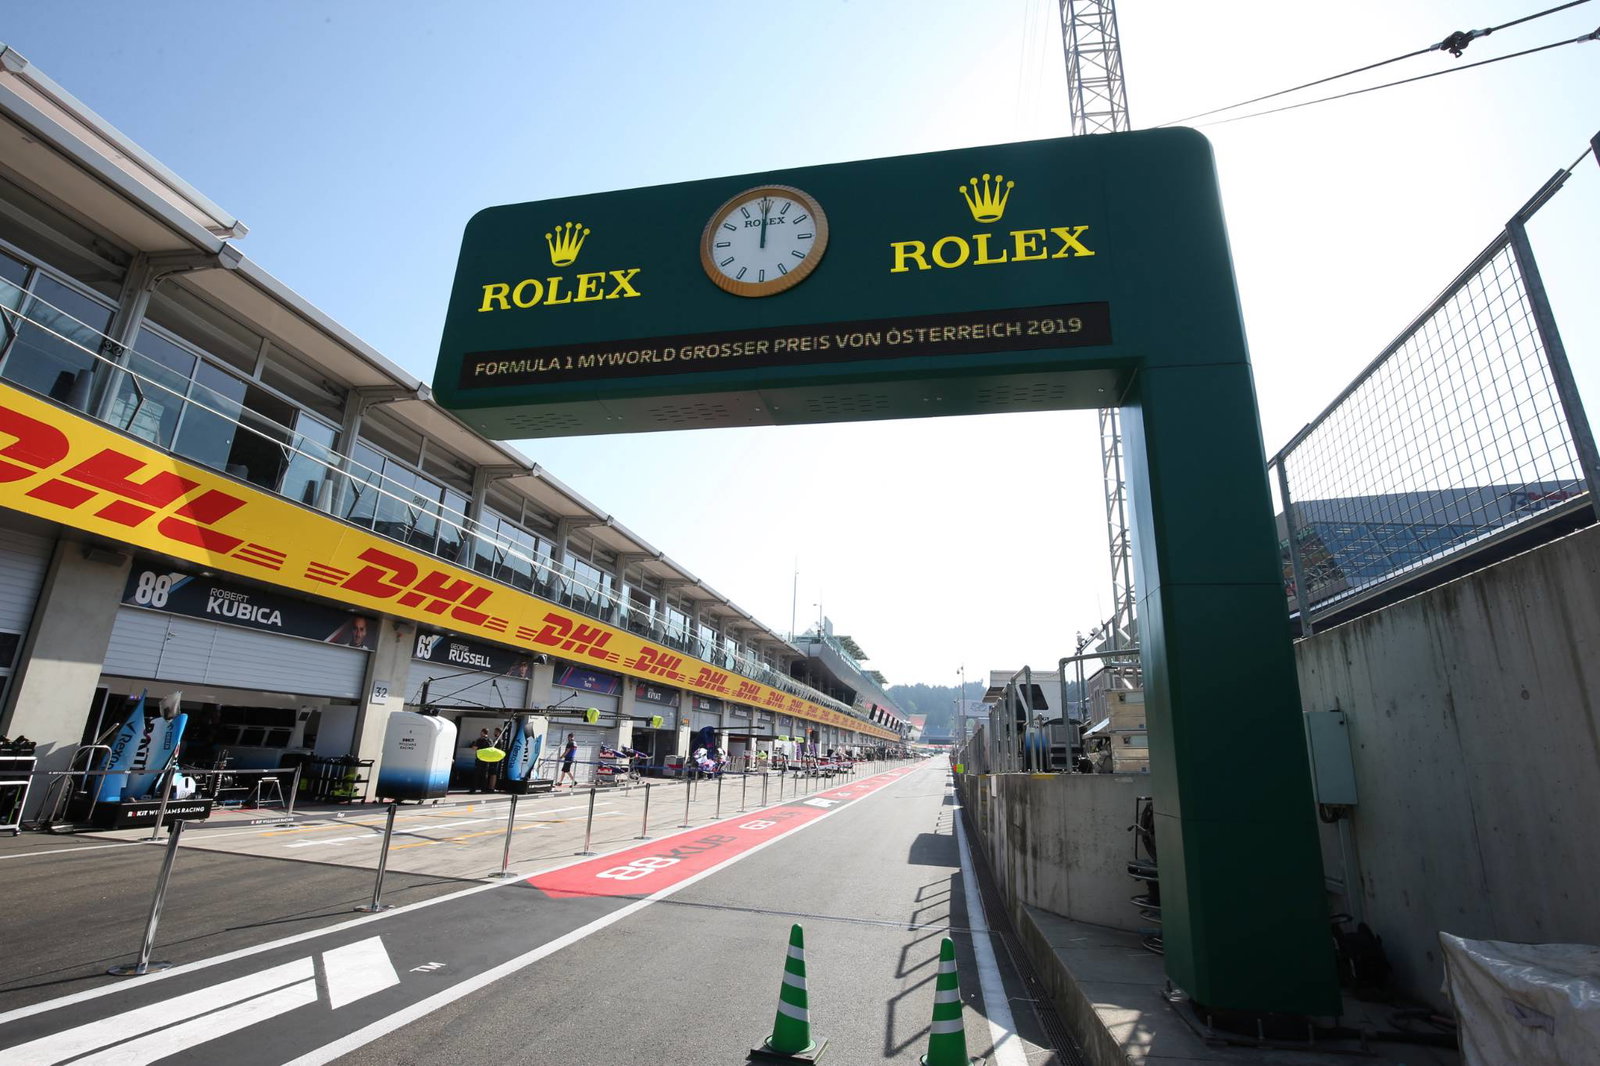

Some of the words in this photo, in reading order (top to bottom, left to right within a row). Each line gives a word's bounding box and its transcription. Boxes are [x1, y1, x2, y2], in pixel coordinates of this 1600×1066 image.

[890, 225, 1095, 273] ROLEX
[477, 268, 641, 312] ROLEX
[475, 356, 560, 377] FORMULA
[565, 355, 573, 370] 1
[577, 347, 676, 369] MYWORLD
[680, 340, 769, 361] GROSSER
[774, 335, 830, 354] PREIS
[836, 330, 881, 349] VON
[886, 321, 1022, 346] ÖSTERREICH
[1027, 317, 1083, 335] 2019
[135, 570, 172, 608] 88
[210, 587, 250, 603] ROBERT
[340, 547, 494, 626] DHL
[206, 596, 282, 627] KUBICA
[416, 634, 433, 660] 63
[533, 612, 613, 660] DHL
[448, 649, 491, 668] RUSSELL
[632, 646, 683, 680] DHL
[375, 686, 388, 698] 32
[694, 667, 728, 693] DHL
[735, 681, 762, 702] DHL
[181, 806, 205, 814] RACING
[595, 856, 681, 881] 88
[654, 834, 737, 860] KUB
[409, 961, 446, 973] TM
